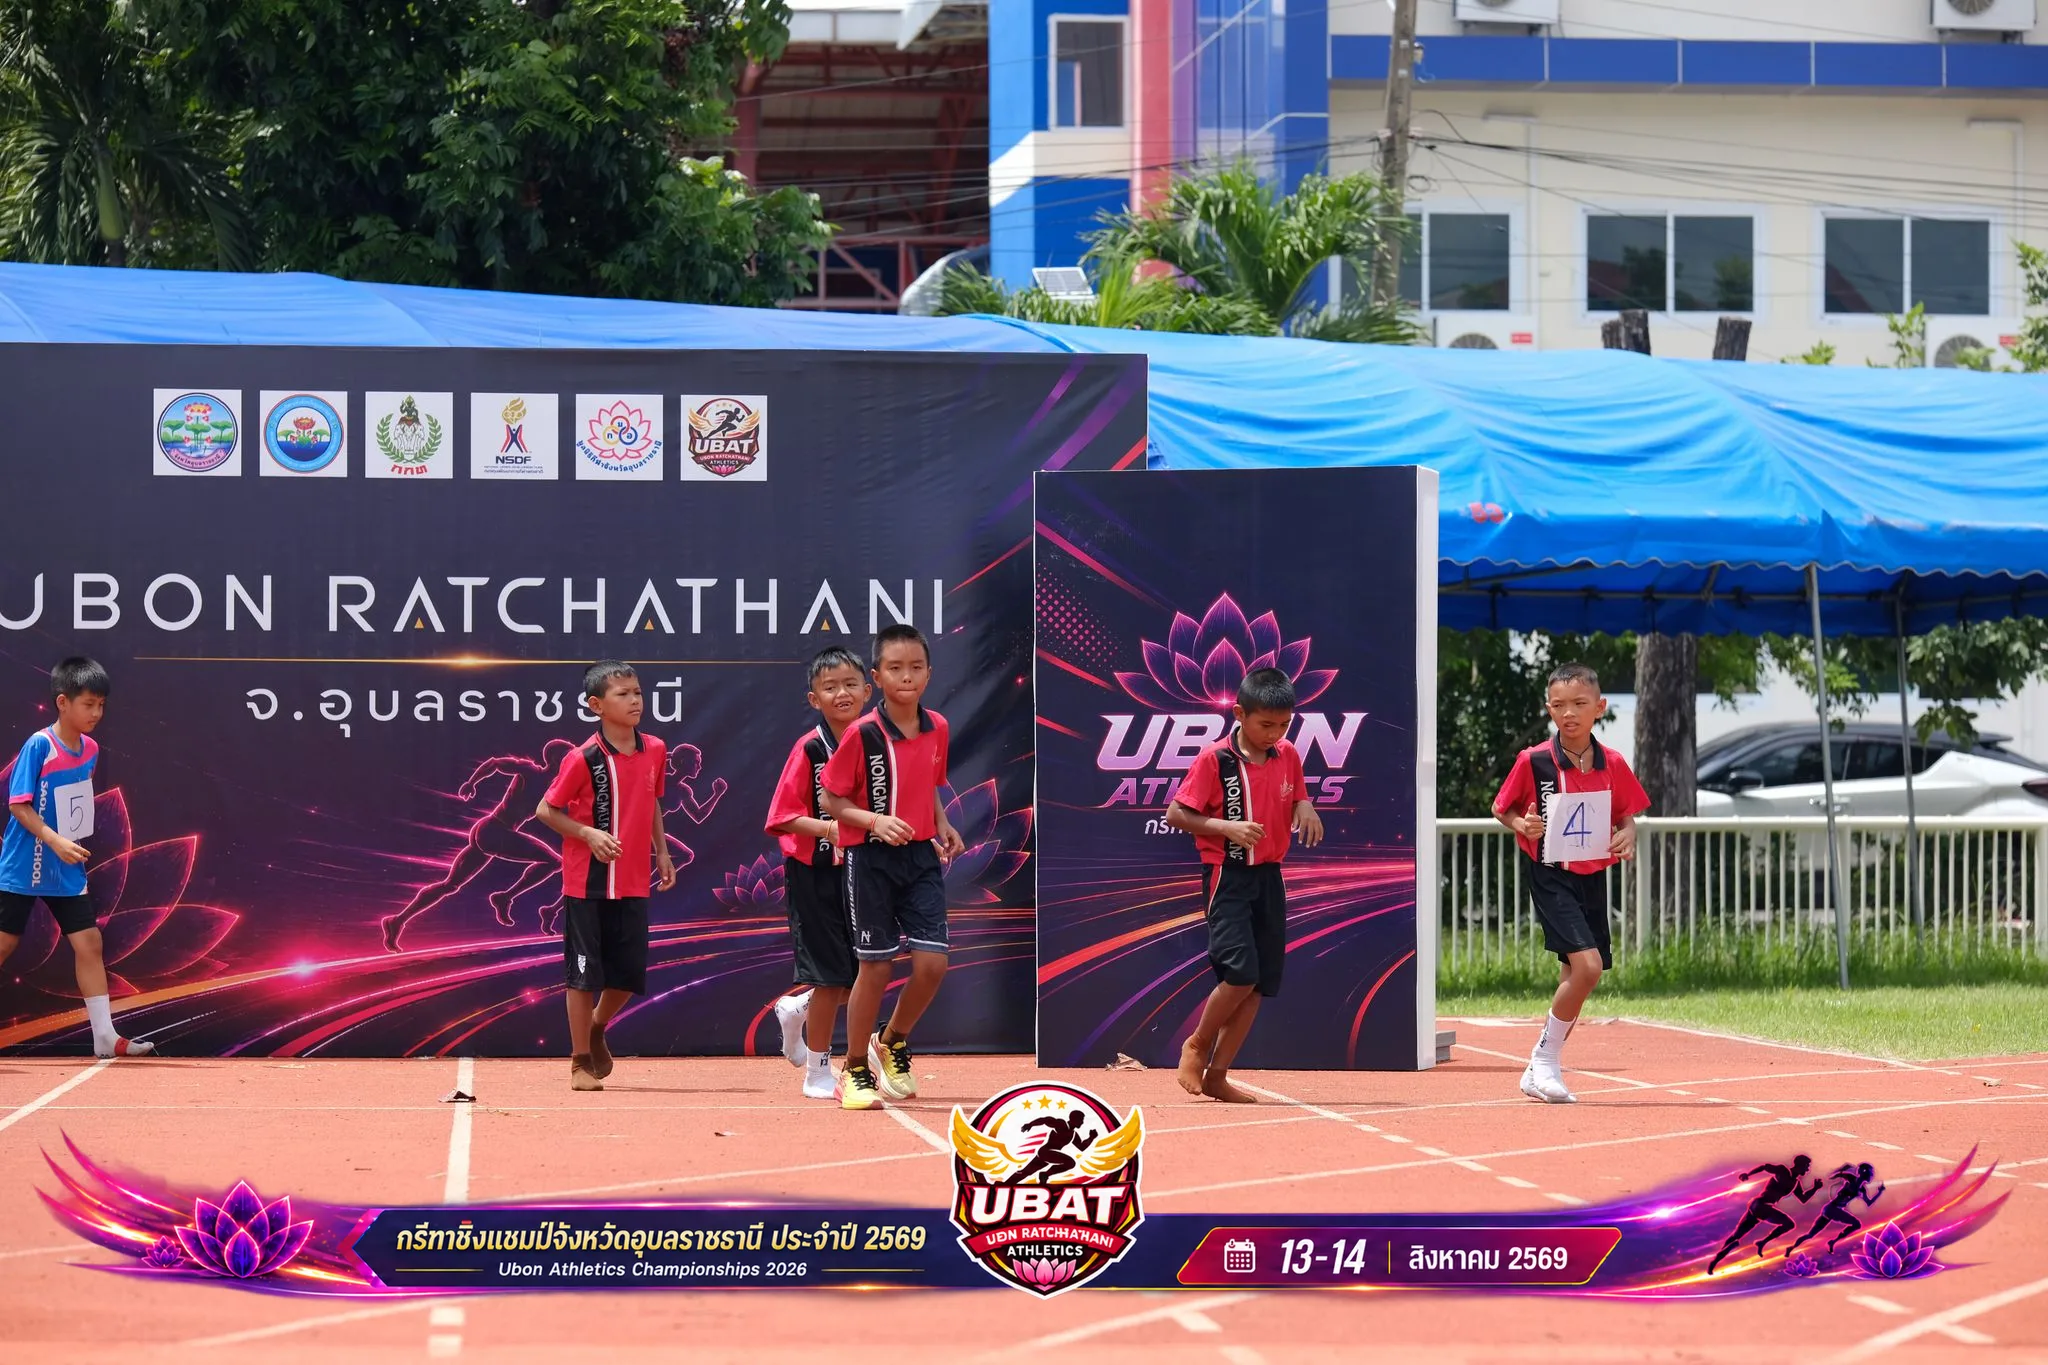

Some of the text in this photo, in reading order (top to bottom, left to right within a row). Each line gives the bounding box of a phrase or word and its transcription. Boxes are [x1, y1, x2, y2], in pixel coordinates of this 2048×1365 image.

[496, 456, 531, 464] NSDF
[695, 439, 753, 454] UBAT
[328, 575, 943, 635] RATCHATHANI
[1096, 711, 1369, 771] UBN
[69, 795, 84, 833] 5
[1562, 801, 1592, 847] 4
